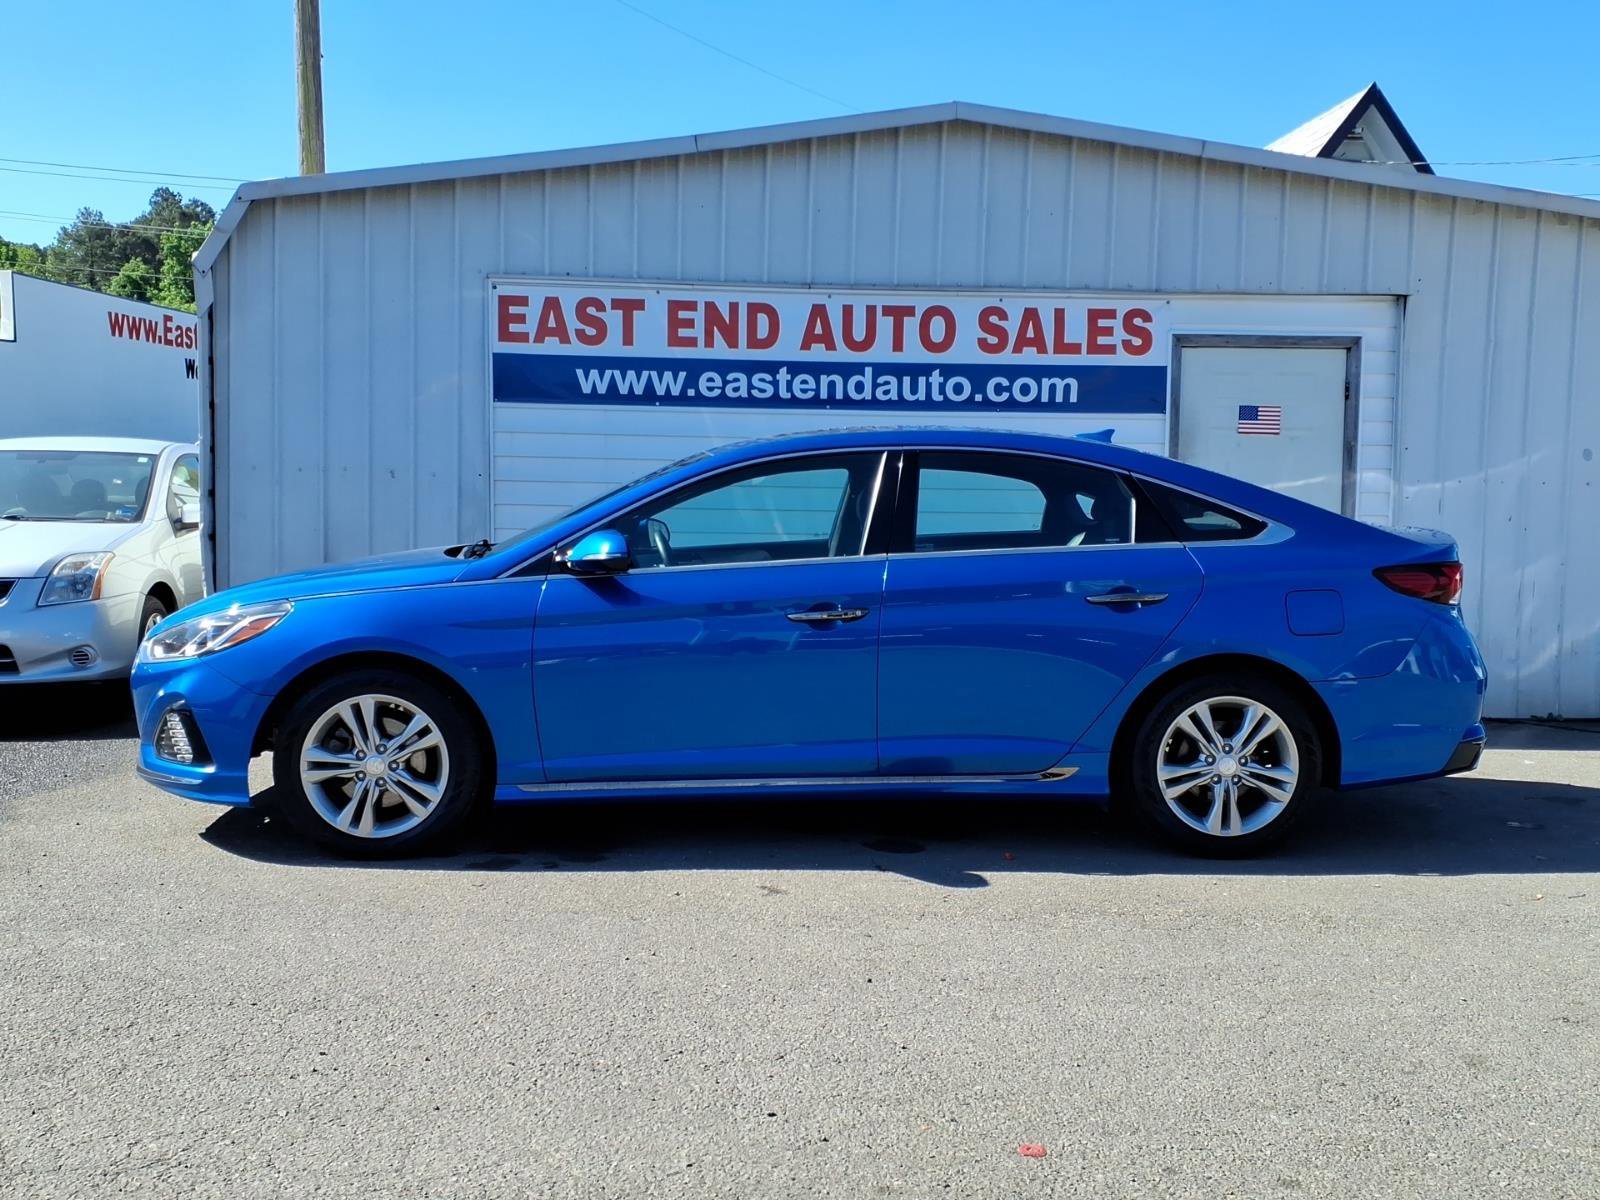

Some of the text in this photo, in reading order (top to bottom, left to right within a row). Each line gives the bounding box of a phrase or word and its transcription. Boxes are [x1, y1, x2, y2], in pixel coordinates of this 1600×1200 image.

[497, 295, 1154, 356] EAST END AUTO SALES
[575, 366, 1079, 403] www.eastendauto.com
